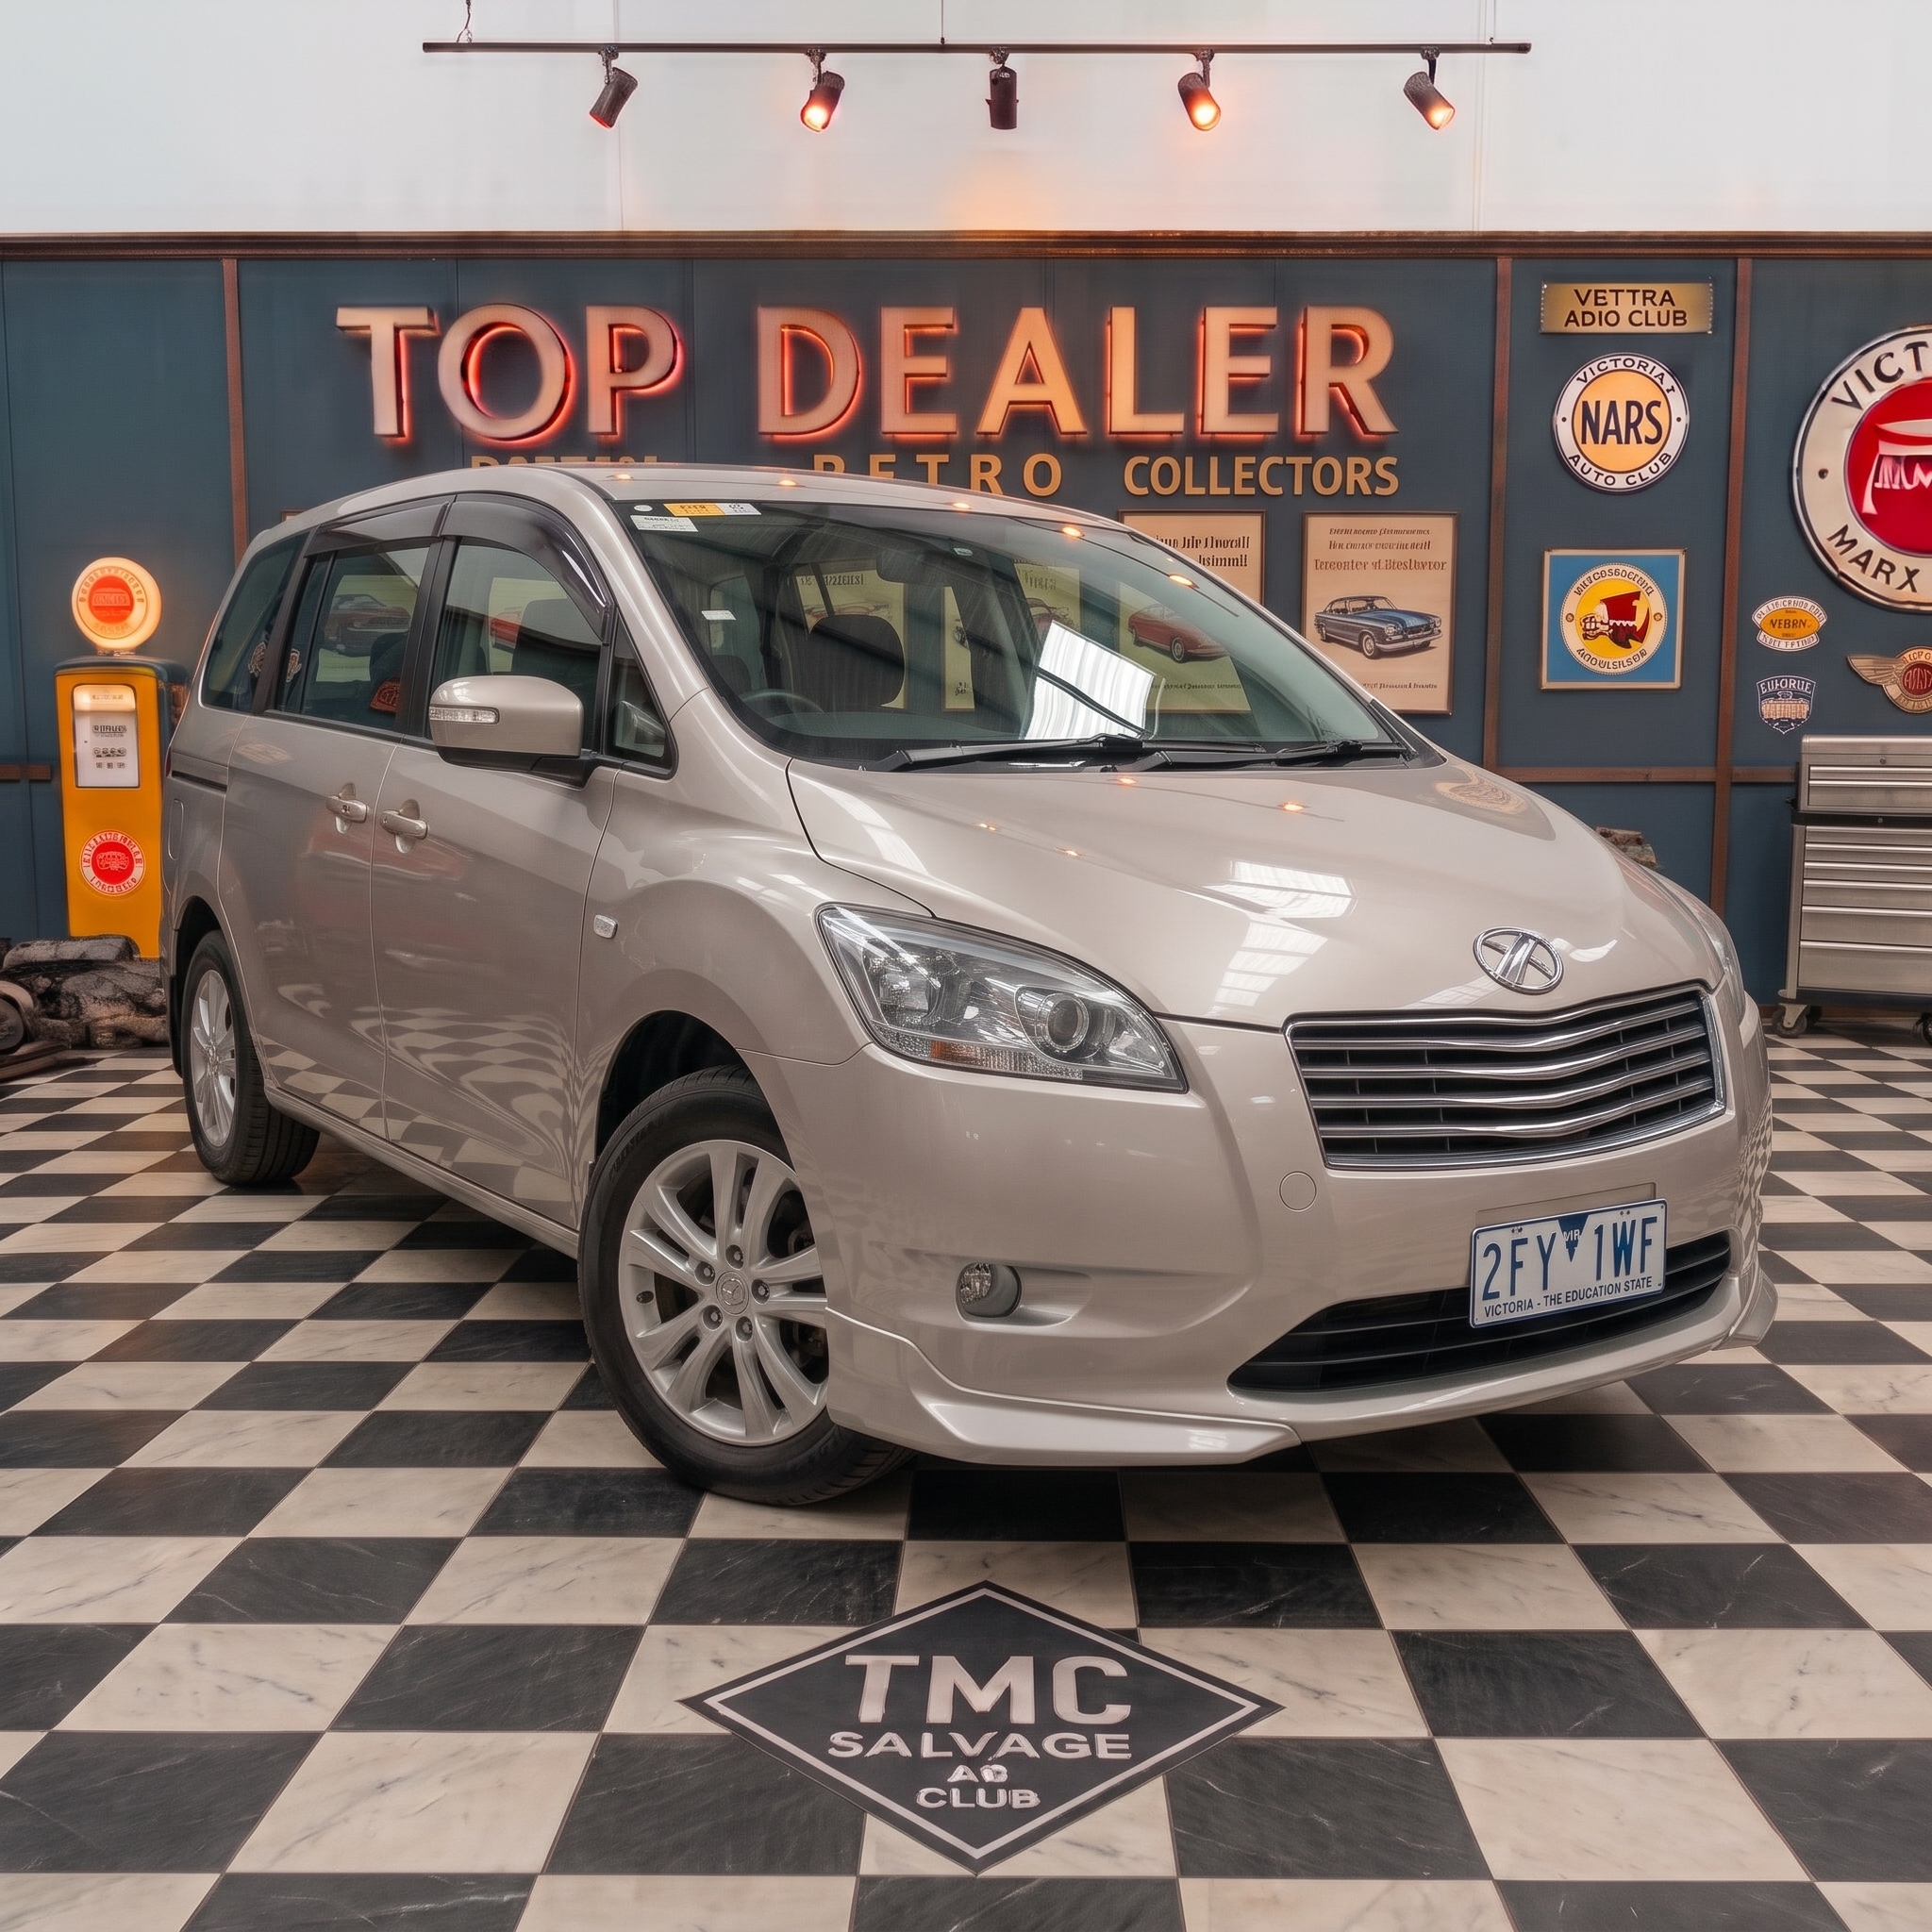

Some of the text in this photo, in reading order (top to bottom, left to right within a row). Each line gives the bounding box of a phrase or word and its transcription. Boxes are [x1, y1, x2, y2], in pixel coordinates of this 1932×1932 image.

[1564, 309, 1688, 327] ADIO CLUB
[1574, 289, 1675, 307] VETTRA
[337, 303, 1399, 441] TOP DEALER
[1581, 400, 1662, 444] NARS
[1124, 456, 1398, 495] COLLECTORS
[1569, 453, 1672, 486] AUTO CLUB
[1826, 524, 1921, 593] MARX
[1482, 1216, 1658, 1302] 2FY 1WF
[1484, 1298, 1534, 1318] VICTORIA
[1543, 1292, 1562, 1307] THE
[1565, 1280, 1622, 1303] EDUCATION
[1624, 1275, 1653, 1292] STATE
[845, 1655, 1132, 1725] TMC
[826, 1731, 1133, 1762] SALVAGE
[916, 1787, 1041, 1809] CLUB
